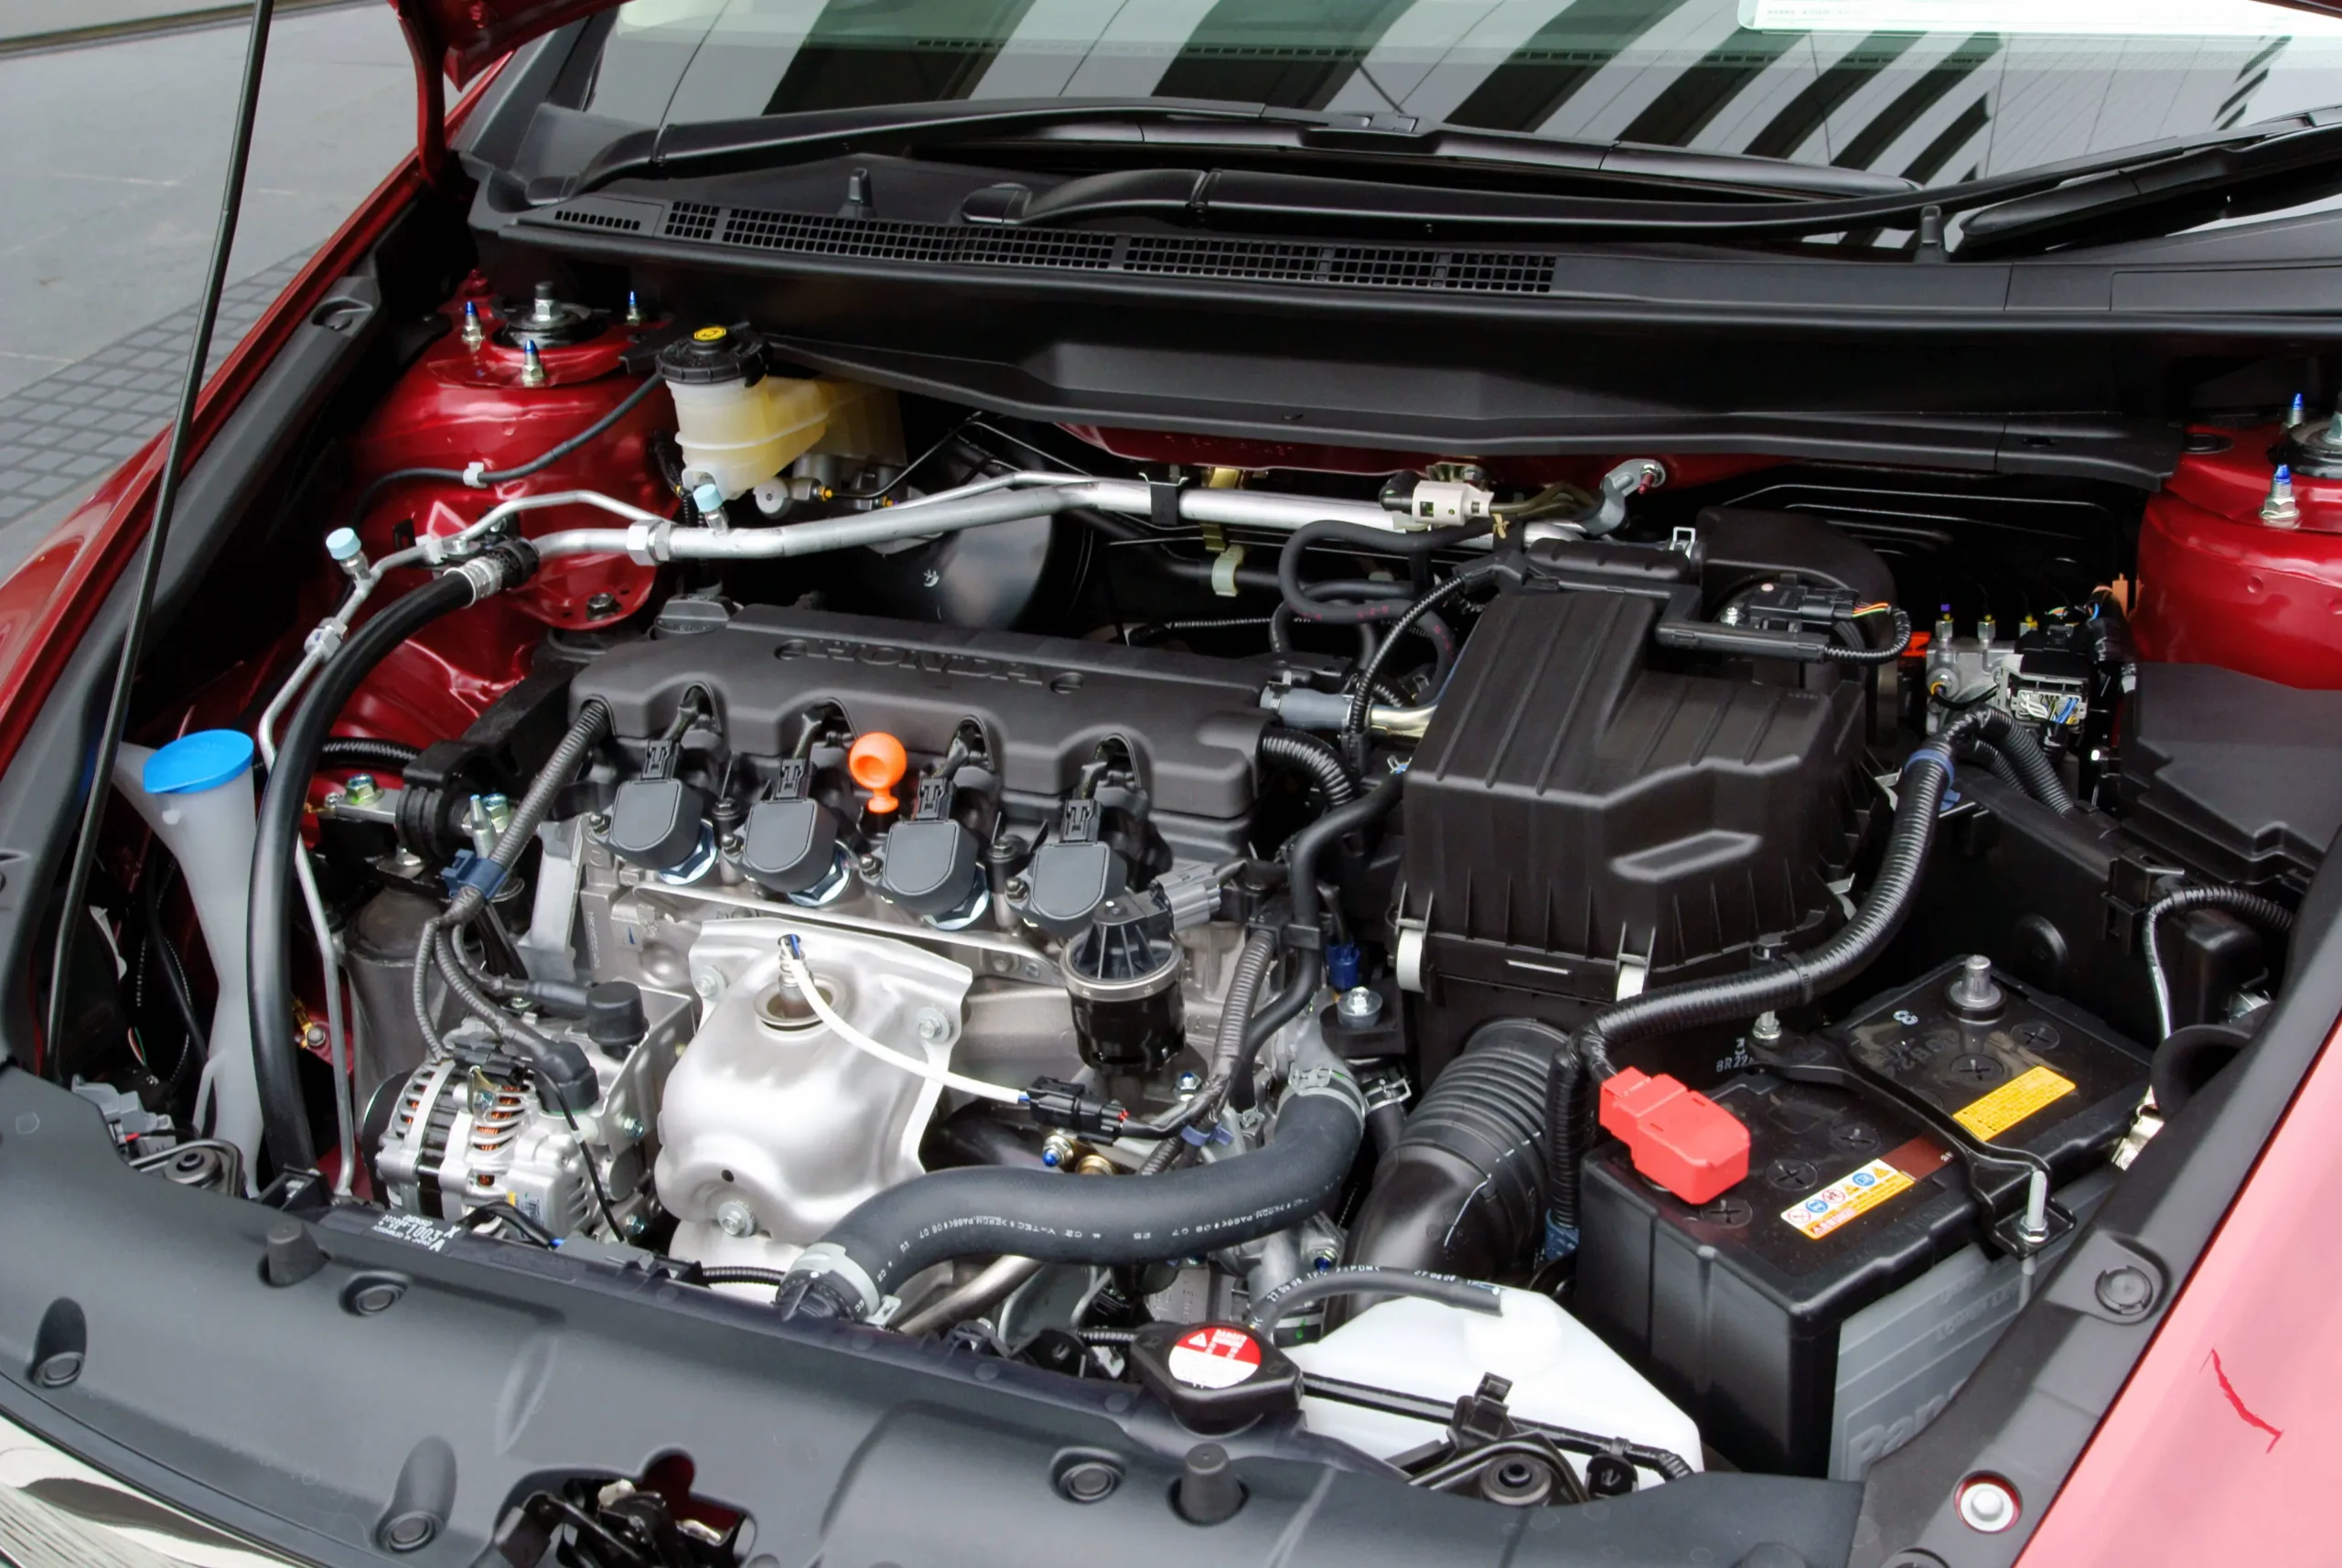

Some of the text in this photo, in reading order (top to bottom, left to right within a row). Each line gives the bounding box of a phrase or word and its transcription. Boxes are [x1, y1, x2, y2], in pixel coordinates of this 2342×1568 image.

[806, 638, 1044, 686] HONDA
[444, 1225, 461, 1239] X
[429, 1238, 446, 1253] A
